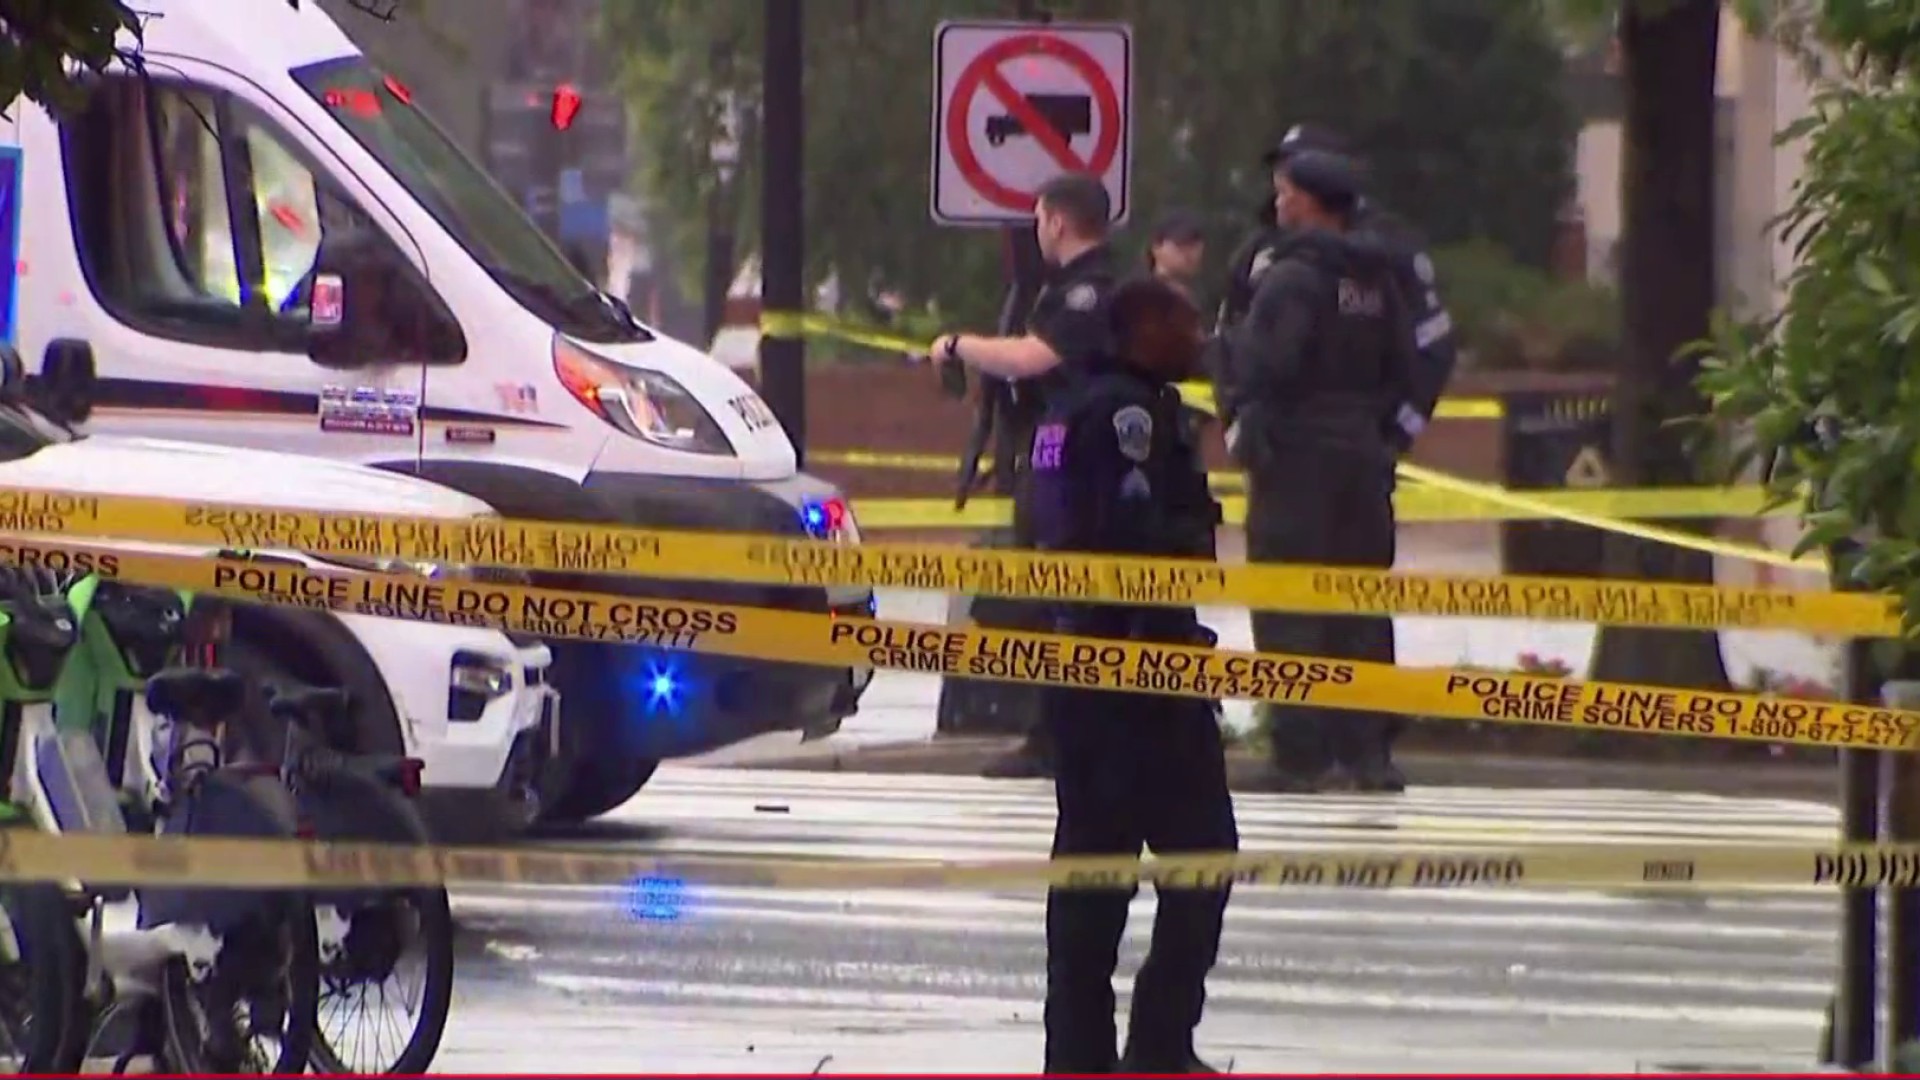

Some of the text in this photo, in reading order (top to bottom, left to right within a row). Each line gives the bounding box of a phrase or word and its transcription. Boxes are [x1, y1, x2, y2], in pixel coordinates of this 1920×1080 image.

[214, 566, 737, 634] POLICE LINE DO NOT CROSS
[831, 623, 1354, 684] POLICE LINE DO NOT CROSS
[869, 647, 1313, 700] CRIME SOLVERS 1-800-673-2777
[1447, 674, 1585, 705] POLICE
[1595, 687, 1679, 712] LINE
[1689, 696, 1743, 715] DO
[1755, 701, 1832, 722] NOT
[1482, 697, 1574, 723] CRIME
[1583, 705, 1715, 733] SOLVERS
